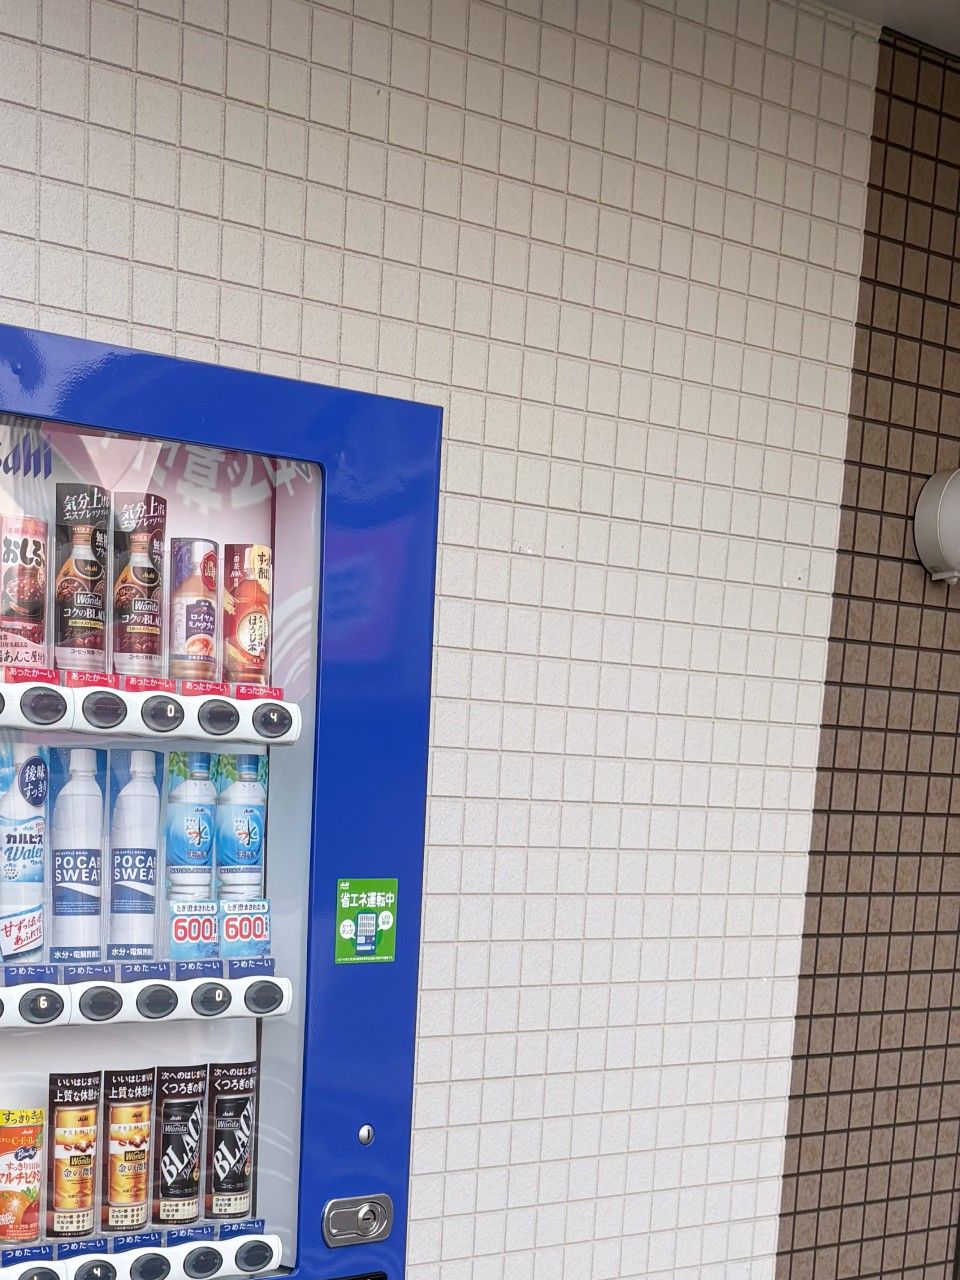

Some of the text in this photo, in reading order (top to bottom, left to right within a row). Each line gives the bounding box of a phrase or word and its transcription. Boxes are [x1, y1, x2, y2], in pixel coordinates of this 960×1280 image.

[76, 593, 101, 605] Wonda
[134, 600, 158, 612] Wonda
[25, 764, 45, 782] 後味
[24, 781, 47, 799] すっきり
[6, 834, 43, 845] カルピス
[341, 892, 394, 908] 省エネ運転中
[174, 918, 213, 941] 600
[225, 916, 264, 940] 600
[164, 1125, 187, 1133] Wonda
[217, 1120, 239, 1128] Wonda
